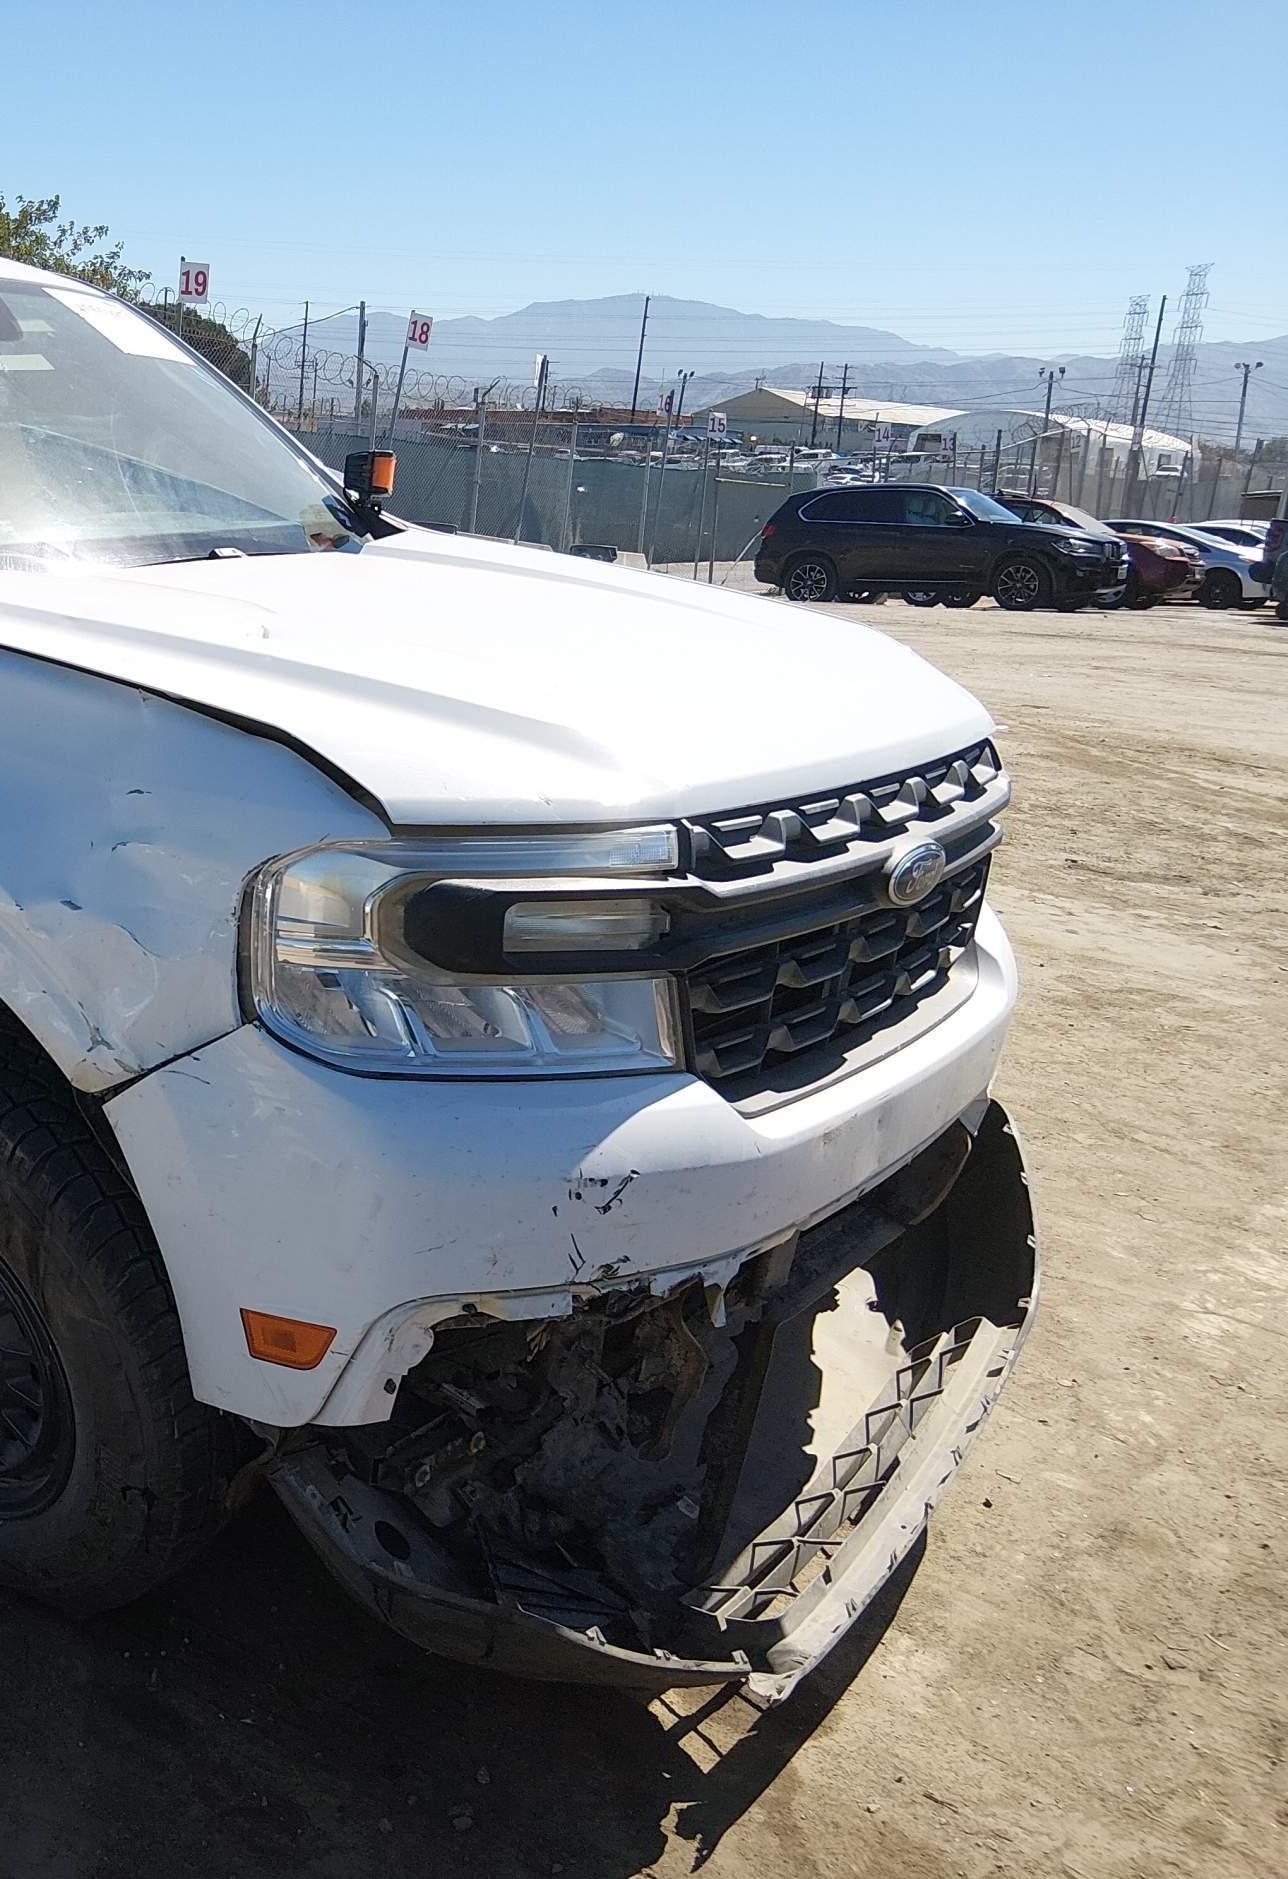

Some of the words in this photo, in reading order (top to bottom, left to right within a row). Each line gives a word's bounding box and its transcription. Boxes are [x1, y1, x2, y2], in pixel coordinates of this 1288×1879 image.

[181, 270, 208, 297] 19
[408, 320, 430, 344] 18
[658, 394, 672, 413] 16
[708, 417, 726, 433] 15
[875, 427, 890, 442] 14
